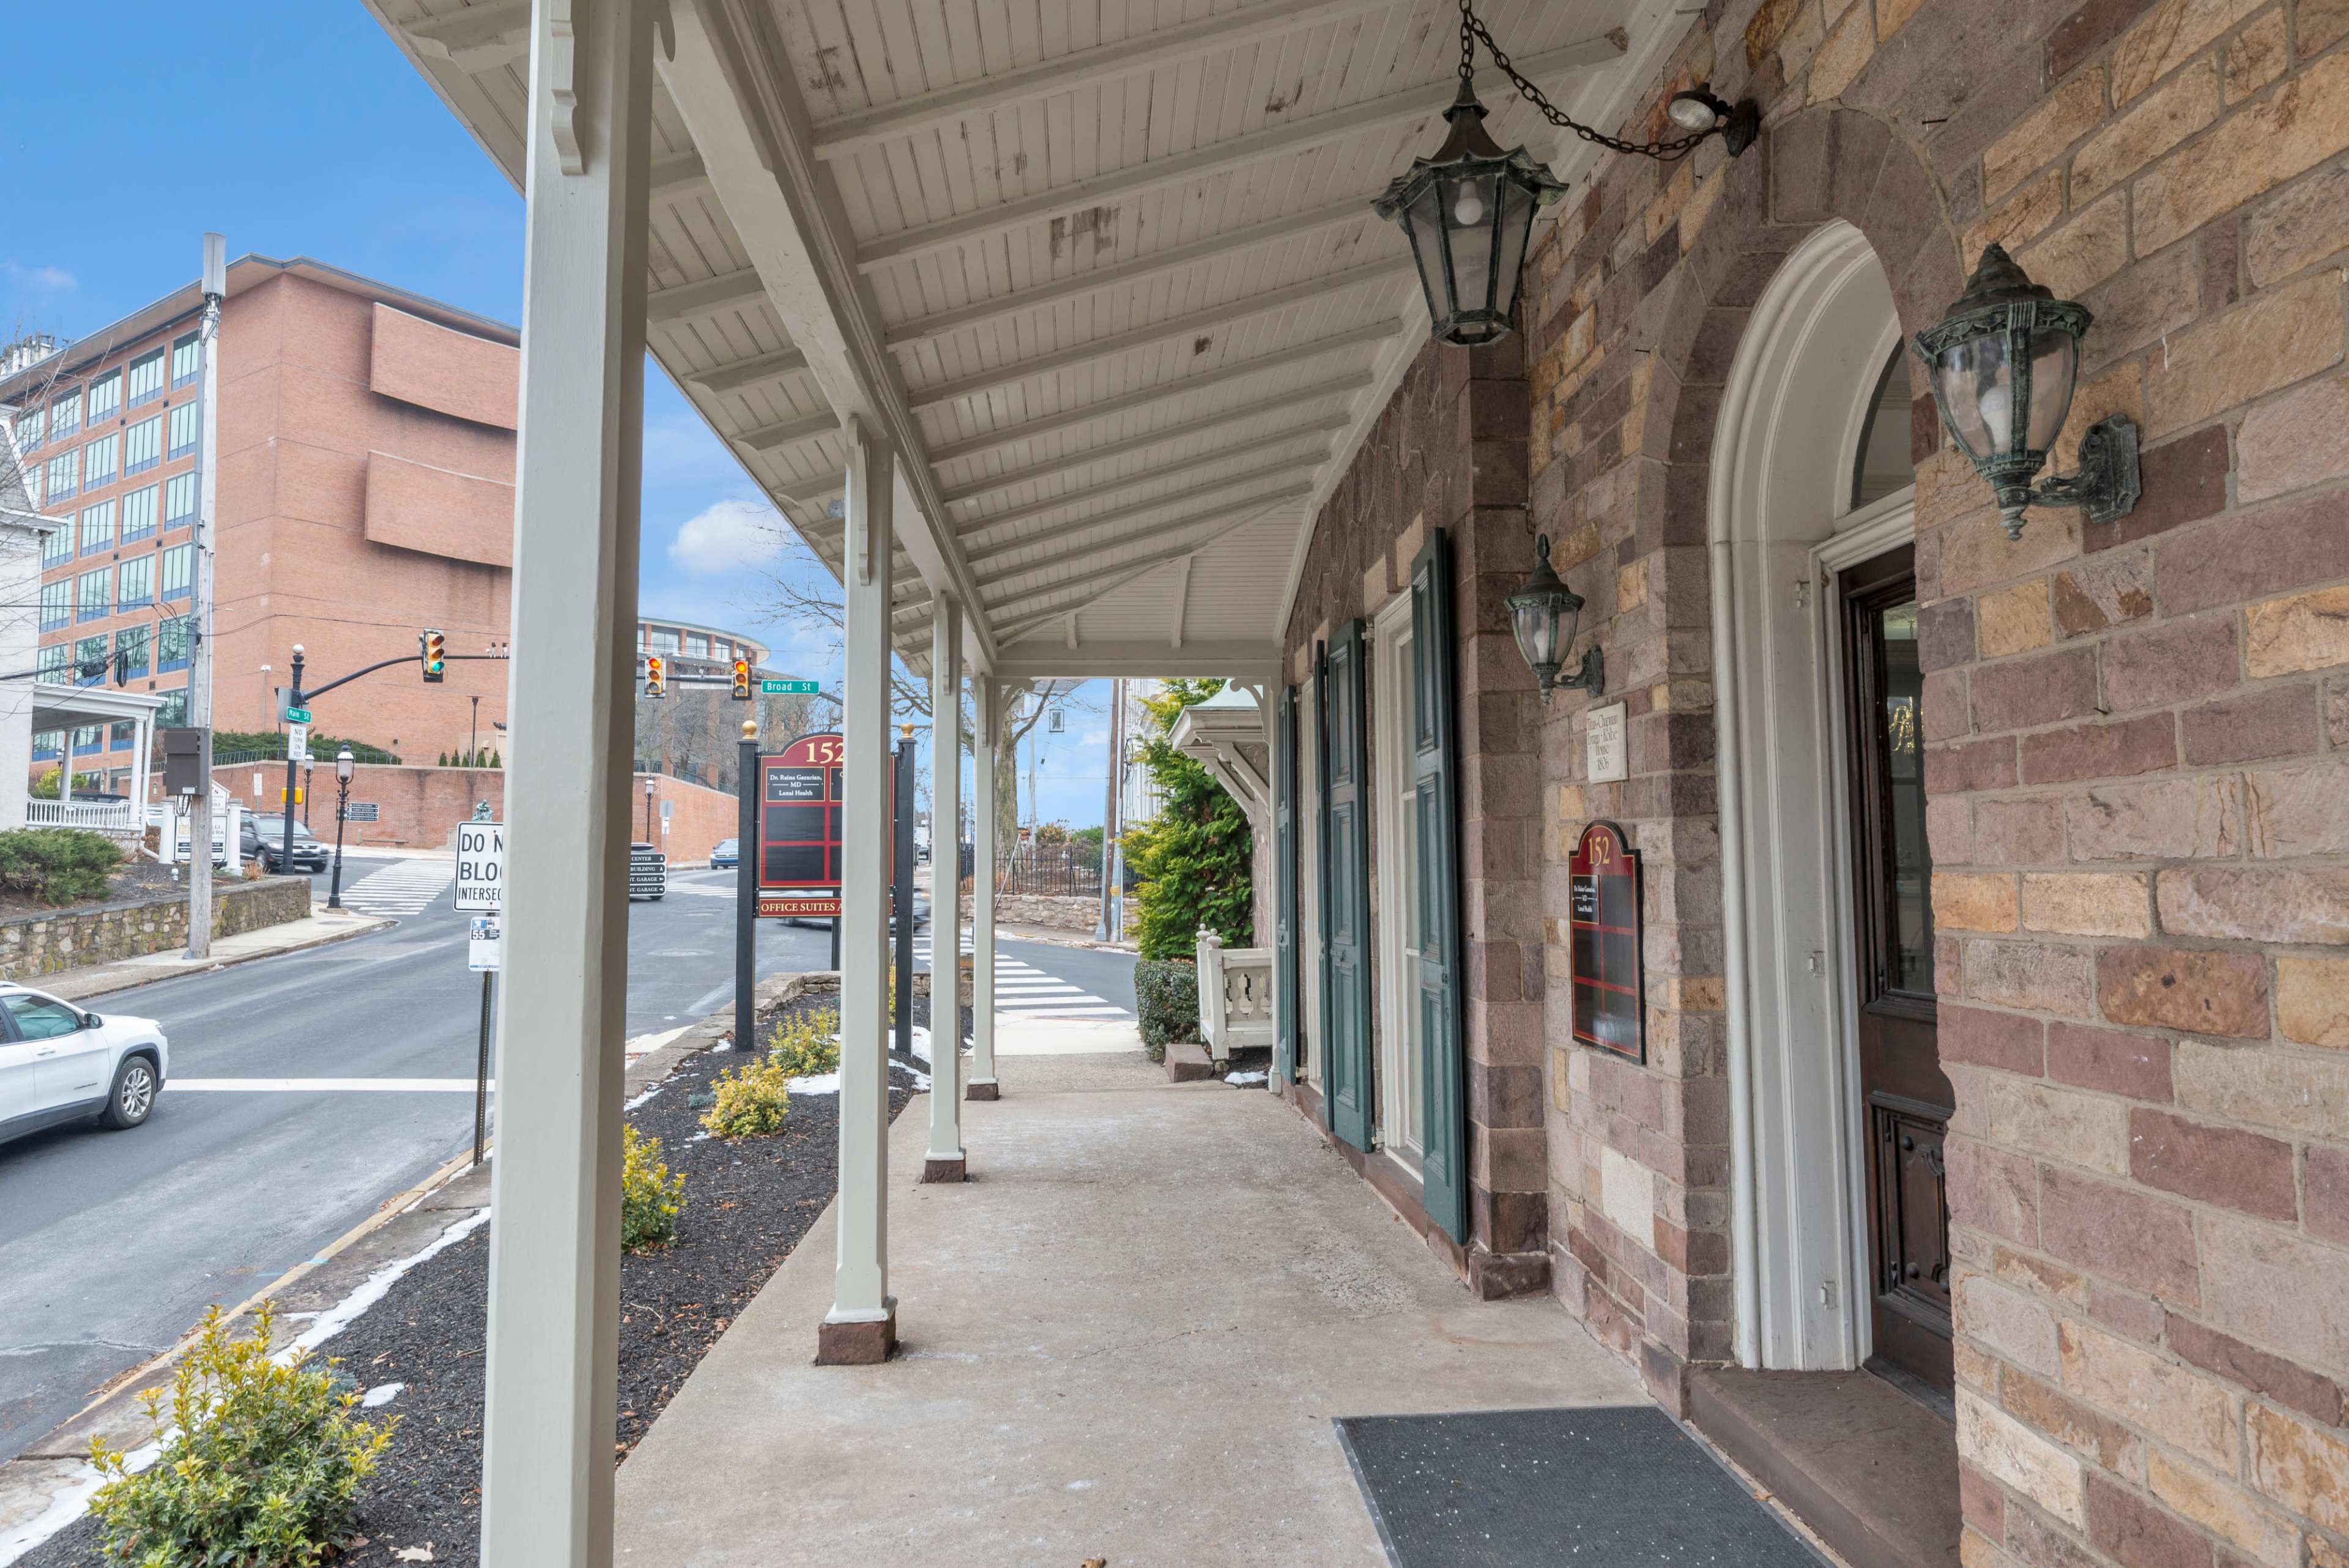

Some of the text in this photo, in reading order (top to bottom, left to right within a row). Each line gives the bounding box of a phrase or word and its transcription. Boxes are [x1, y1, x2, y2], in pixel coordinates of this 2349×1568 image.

[767, 682, 792, 691] Broad
[289, 709, 300, 718] Main
[806, 742, 843, 764] 152
[1595, 742, 1609, 756] House
[461, 833, 485, 853] DO
[1588, 836, 1610, 867] 152
[460, 861, 502, 882] BLO
[458, 887, 502, 901] INTERSEC
[760, 903, 798, 912] OFFICE
[800, 902, 836, 911] SUITES
[472, 930, 485, 940] 55
